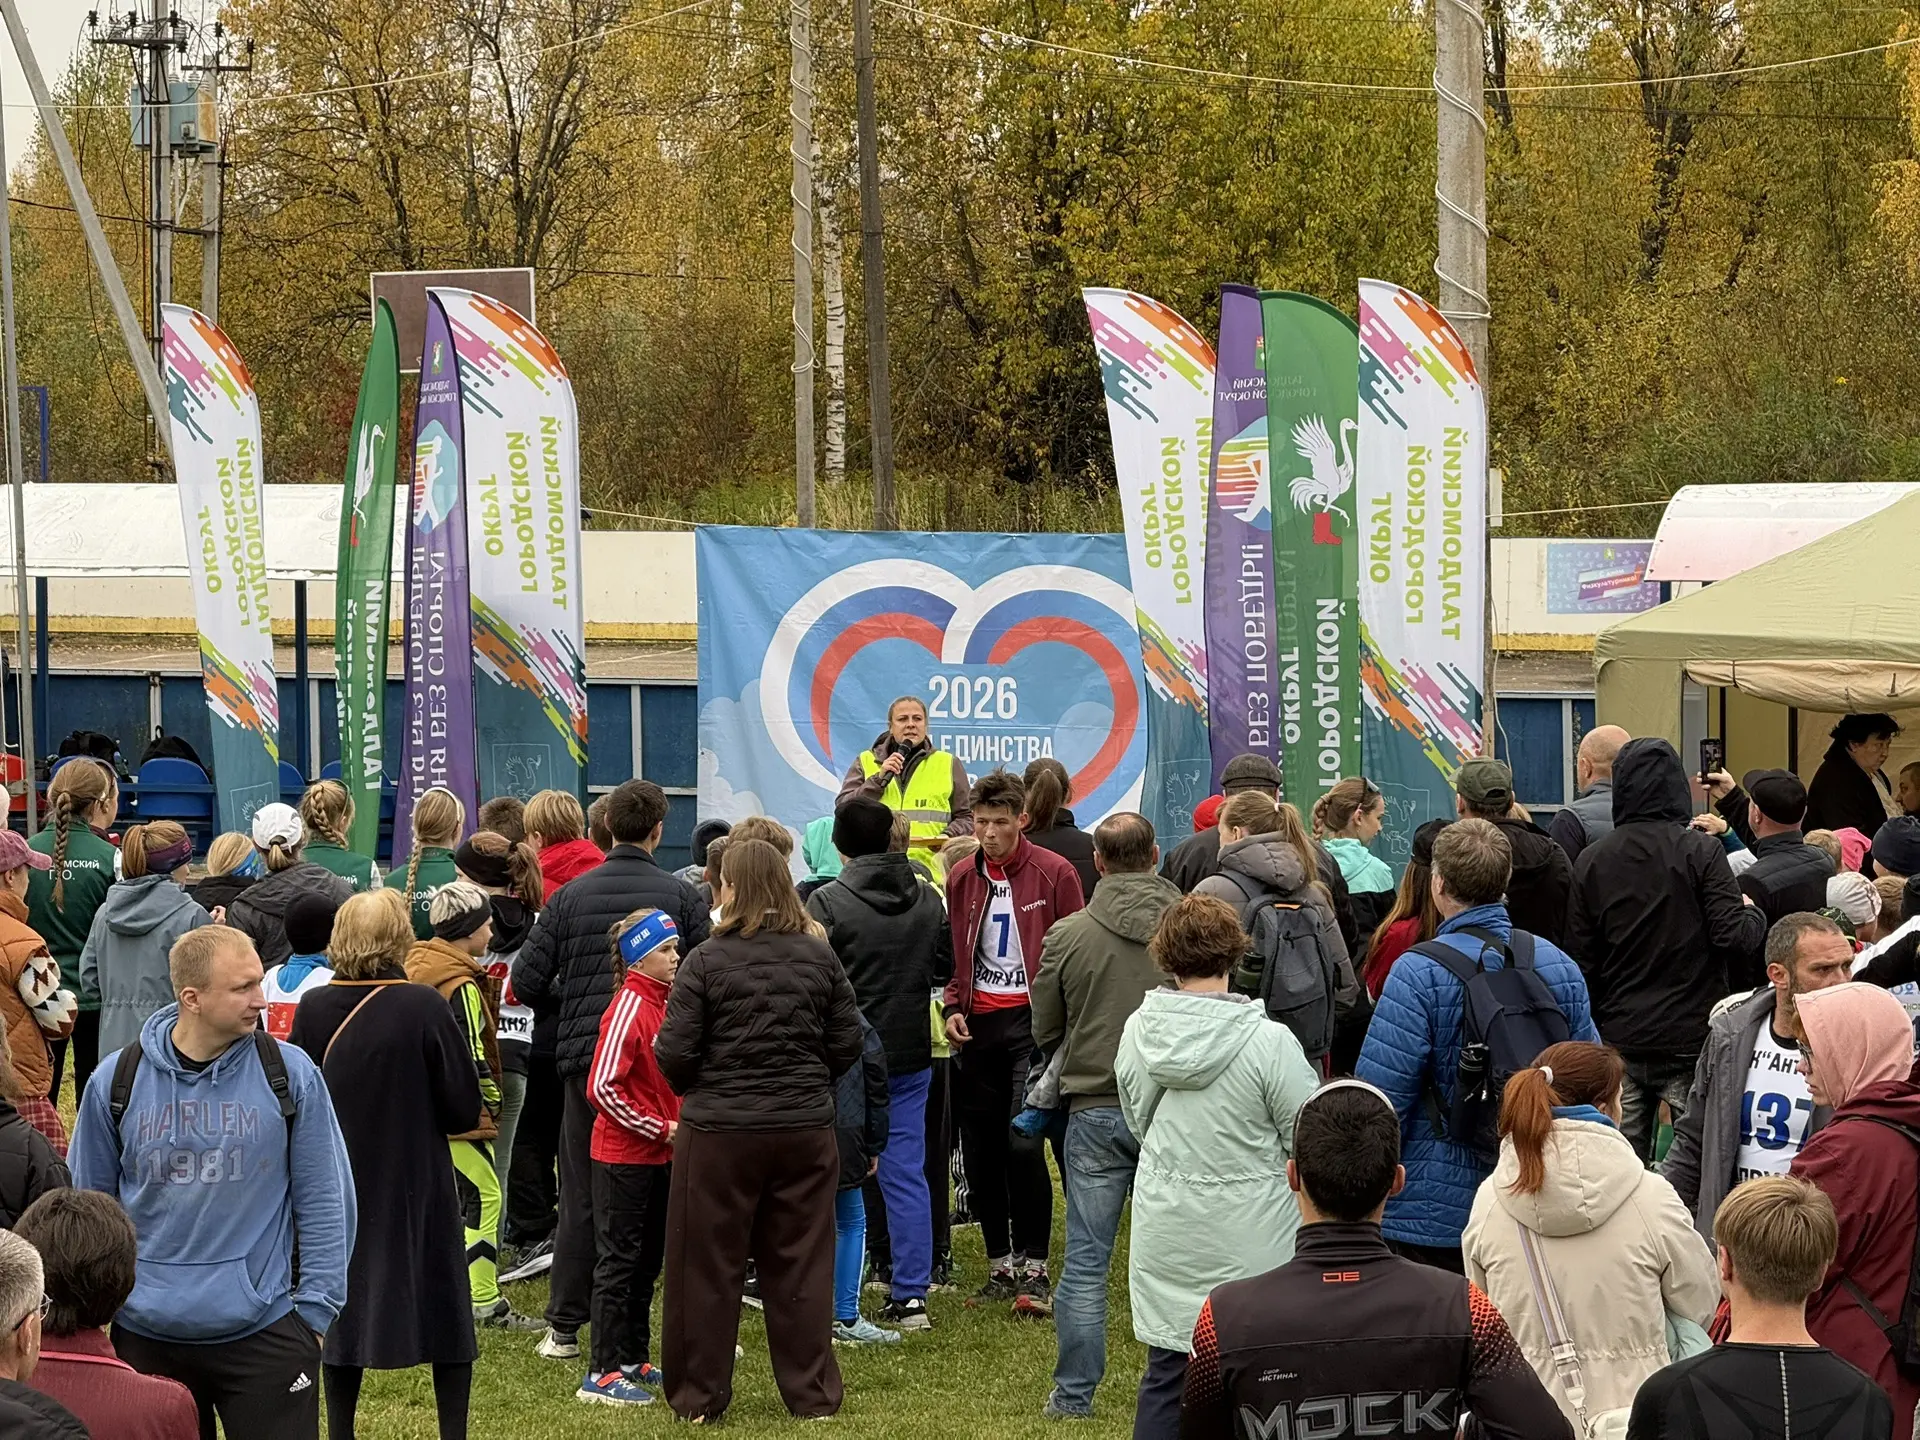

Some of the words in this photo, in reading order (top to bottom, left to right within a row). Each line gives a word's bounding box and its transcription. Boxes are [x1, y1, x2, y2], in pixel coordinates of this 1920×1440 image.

[928, 675, 1018, 720] 2026
[940, 734, 1055, 764] ЕДИНСТВА
[992, 913, 1011, 958] 7
[137, 1099, 261, 1149] HARLEM
[148, 1144, 245, 1185] 1981
[1257, 1371, 1298, 1383] «ИСТИНА»
